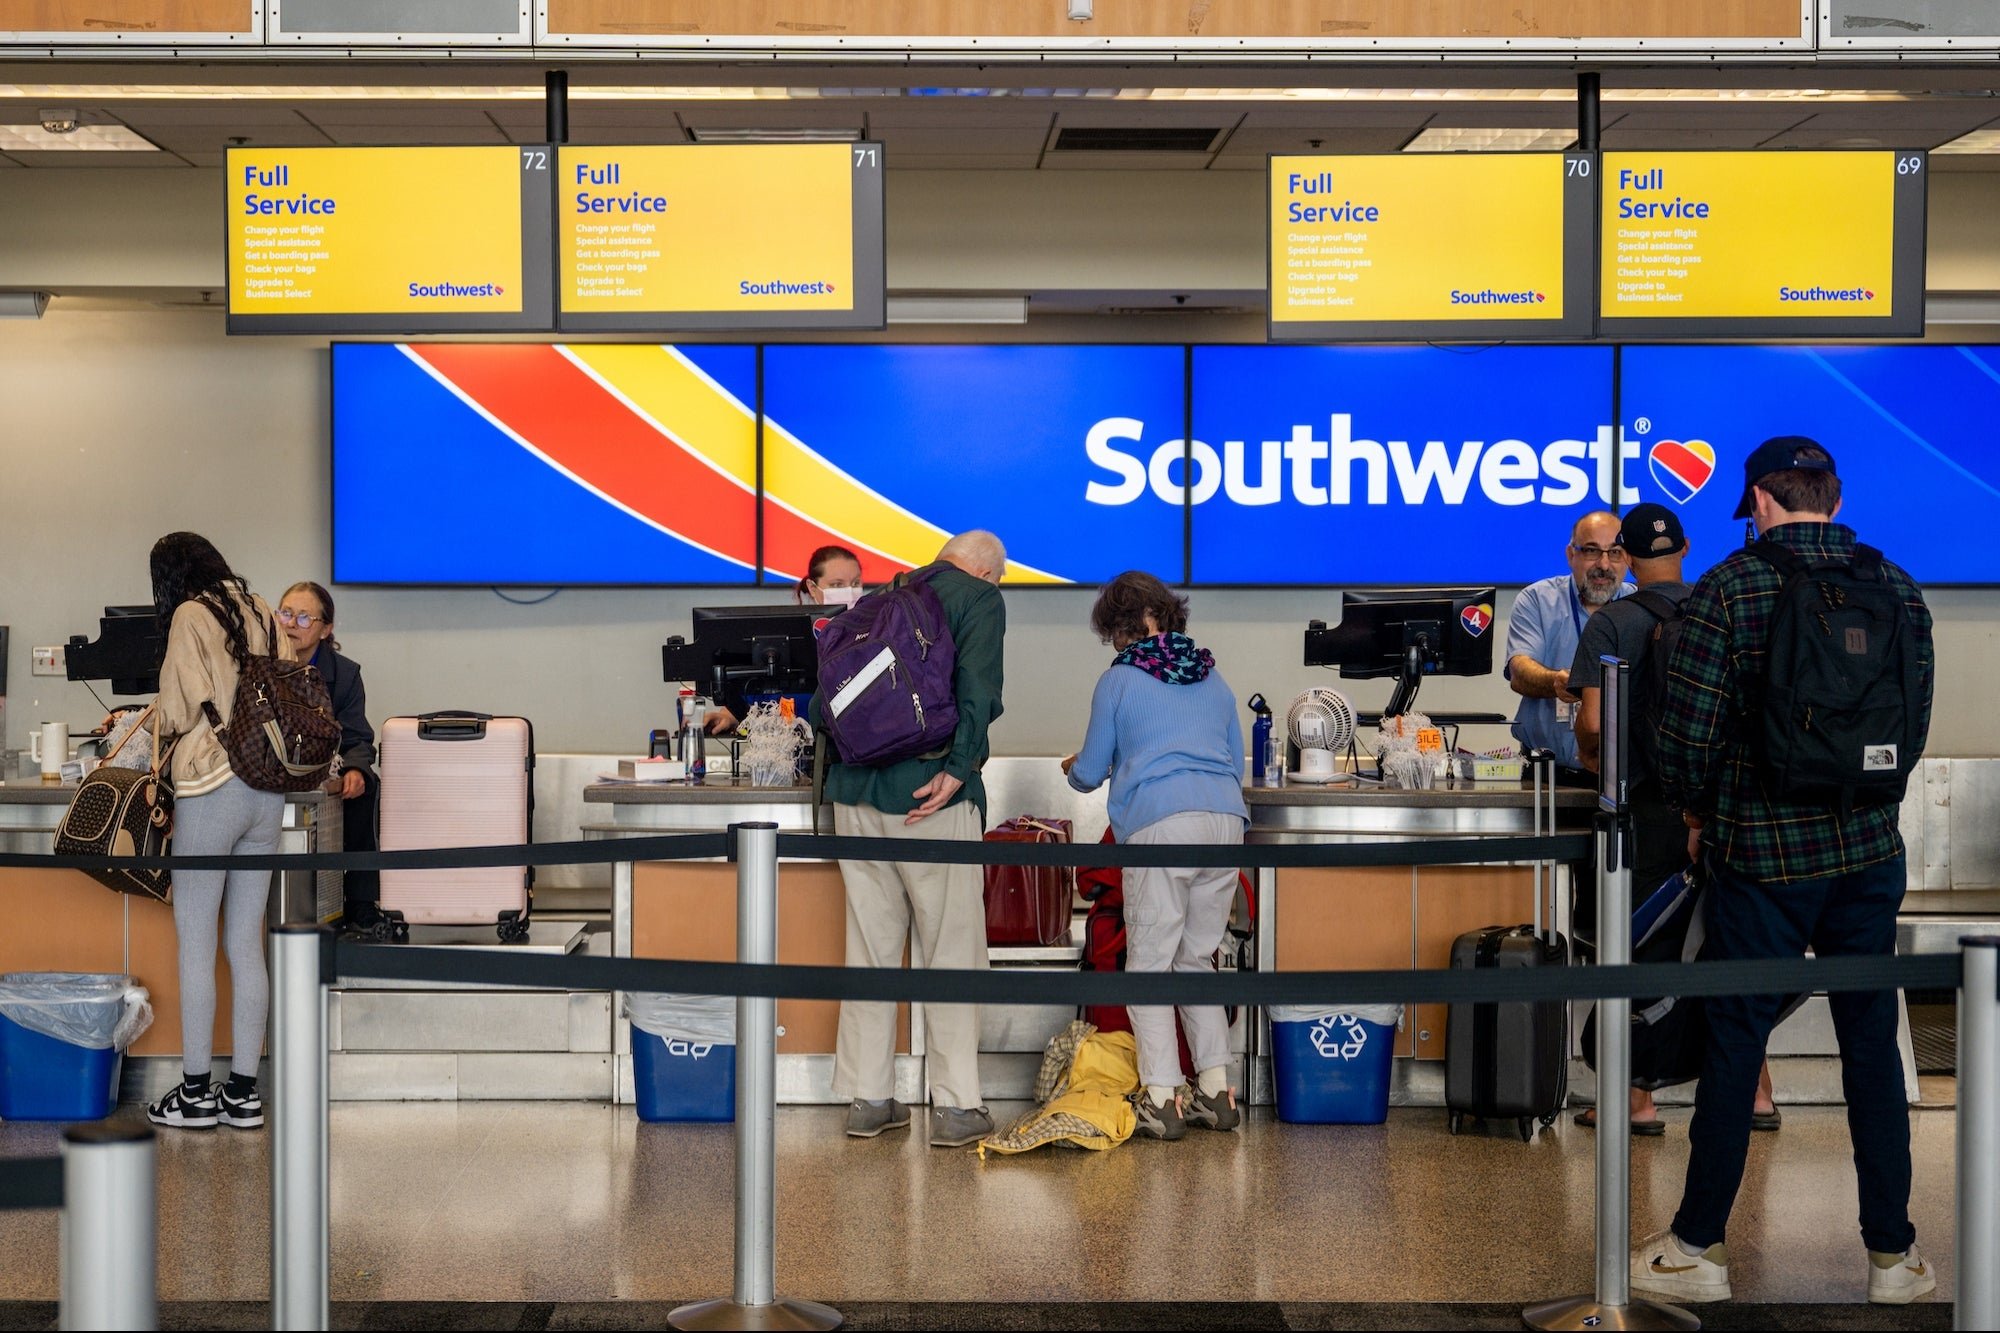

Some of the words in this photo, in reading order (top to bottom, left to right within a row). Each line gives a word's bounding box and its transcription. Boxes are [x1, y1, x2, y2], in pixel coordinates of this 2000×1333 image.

[523, 152, 547, 170] 72
[854, 149, 876, 168] 71
[1566, 159, 1590, 177] 70
[1897, 157, 1922, 175] 69
[245, 166, 288, 187] Full
[576, 164, 619, 185] Full
[1619, 169, 1663, 191] Full
[1289, 173, 1332, 193] Full
[245, 194, 336, 215] Service
[576, 192, 667, 213] Service
[1288, 201, 1379, 223] Service
[1619, 198, 1710, 219] Service
[245, 226, 277, 236] Change
[279, 227, 298, 236] your
[301, 225, 324, 236] flight
[576, 224, 608, 234] Change
[610, 225, 629, 234] your
[632, 223, 656, 234] flight
[1618, 229, 1650, 240] Change
[1652, 230, 1672, 240] your
[1674, 228, 1697, 240] flight
[245, 238, 276, 248] Special
[576, 237, 606, 247] Special
[1288, 233, 1321, 243] Change
[1322, 235, 1342, 243] your
[1343, 233, 1367, 243] flight
[1288, 247, 1318, 256] Special
[1320, 246, 1364, 254] assistance
[1618, 242, 1648, 252] Special
[1650, 242, 1694, 250] assistance
[245, 252, 260, 260] Get
[269, 251, 308, 261] boarding
[576, 250, 591, 258] Get
[600, 249, 640, 259] boarding
[641, 251, 661, 259] pass
[1618, 255, 1632, 263] Get
[1642, 254, 1680, 265] boarding
[1682, 256, 1702, 264] pass
[245, 264, 272, 272] Check
[274, 266, 292, 274] your
[295, 264, 316, 274] bags
[577, 263, 603, 271] Check
[605, 264, 625, 273] your
[626, 263, 648, 273] bags
[1288, 259, 1303, 267] Get
[1312, 259, 1351, 269] boarding
[1353, 260, 1371, 268] pass
[1288, 272, 1314, 281] Check
[1316, 273, 1335, 282] your
[1338, 272, 1359, 282] bags
[1618, 268, 1644, 276] Check
[1646, 270, 1665, 278] your
[1667, 267, 1688, 278] bags
[246, 278, 283, 288] Upgrade
[577, 277, 614, 287] Upgrade
[1617, 282, 1654, 292] Upgrade
[246, 289, 283, 298] Business
[285, 289, 312, 298] Select
[409, 283, 493, 297] Southwest
[577, 287, 613, 296] Business
[616, 287, 643, 296] Select
[740, 281, 824, 295] Southwest
[1288, 286, 1325, 296] Upgrade
[1451, 290, 1534, 304] Southwest
[1617, 293, 1654, 302] Business
[1656, 293, 1683, 302] Select
[1779, 287, 1862, 301] Southwest
[1288, 297, 1325, 305] Business
[1327, 297, 1354, 305] Select
[1470, 611, 1481, 628] 4
[1417, 735, 1439, 744] GILE
